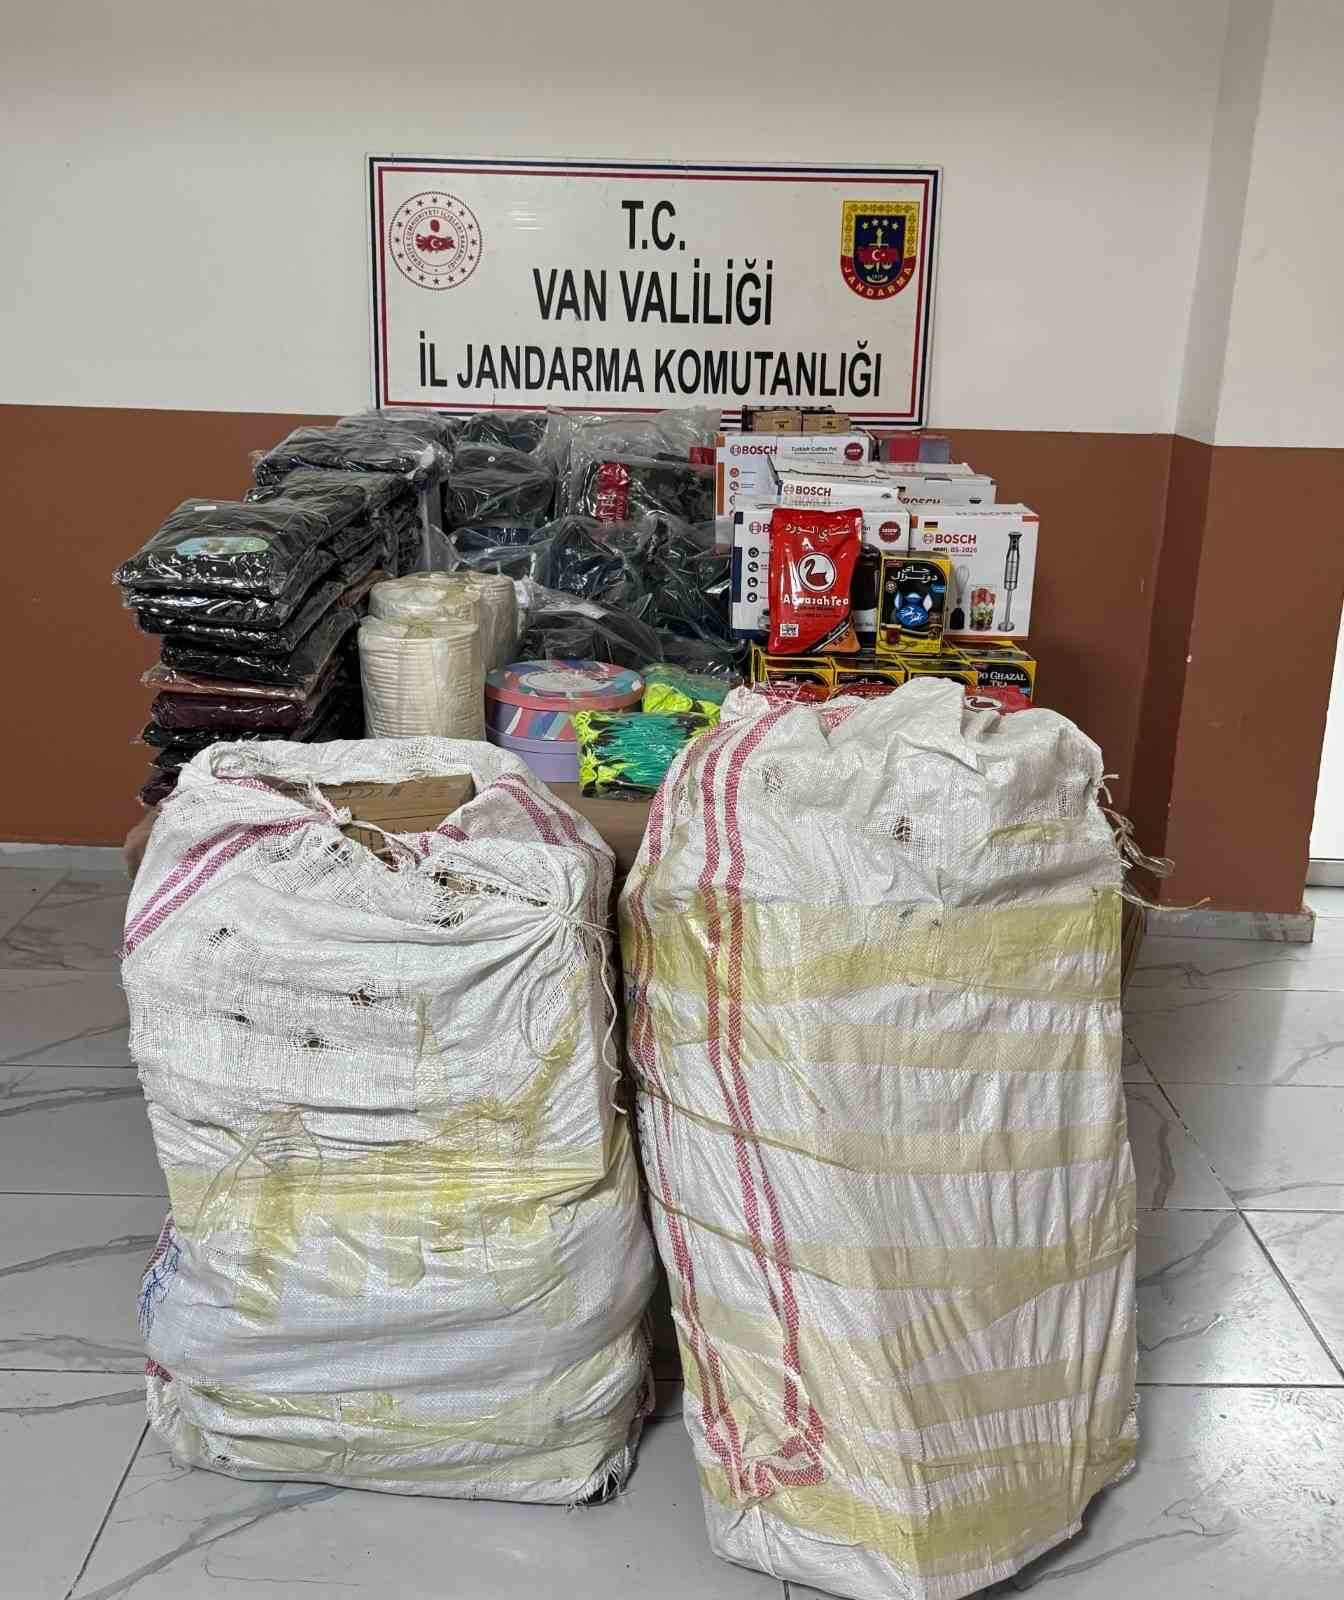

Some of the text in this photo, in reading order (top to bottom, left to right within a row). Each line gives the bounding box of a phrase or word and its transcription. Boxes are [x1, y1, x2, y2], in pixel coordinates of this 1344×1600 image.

[622, 201, 686, 250] T.C.
[844, 267, 912, 296] JANDARMA
[533, 259, 773, 325] VAN VALİLİĞİ
[420, 331, 881, 397] İL JANDARMA KOMUTANLIĞI
[742, 446, 777, 455] BOSCH
[795, 485, 831, 496] BOSCH
[935, 534, 976, 544] BOSCH
[990, 671, 1026, 681] GHAZAL
